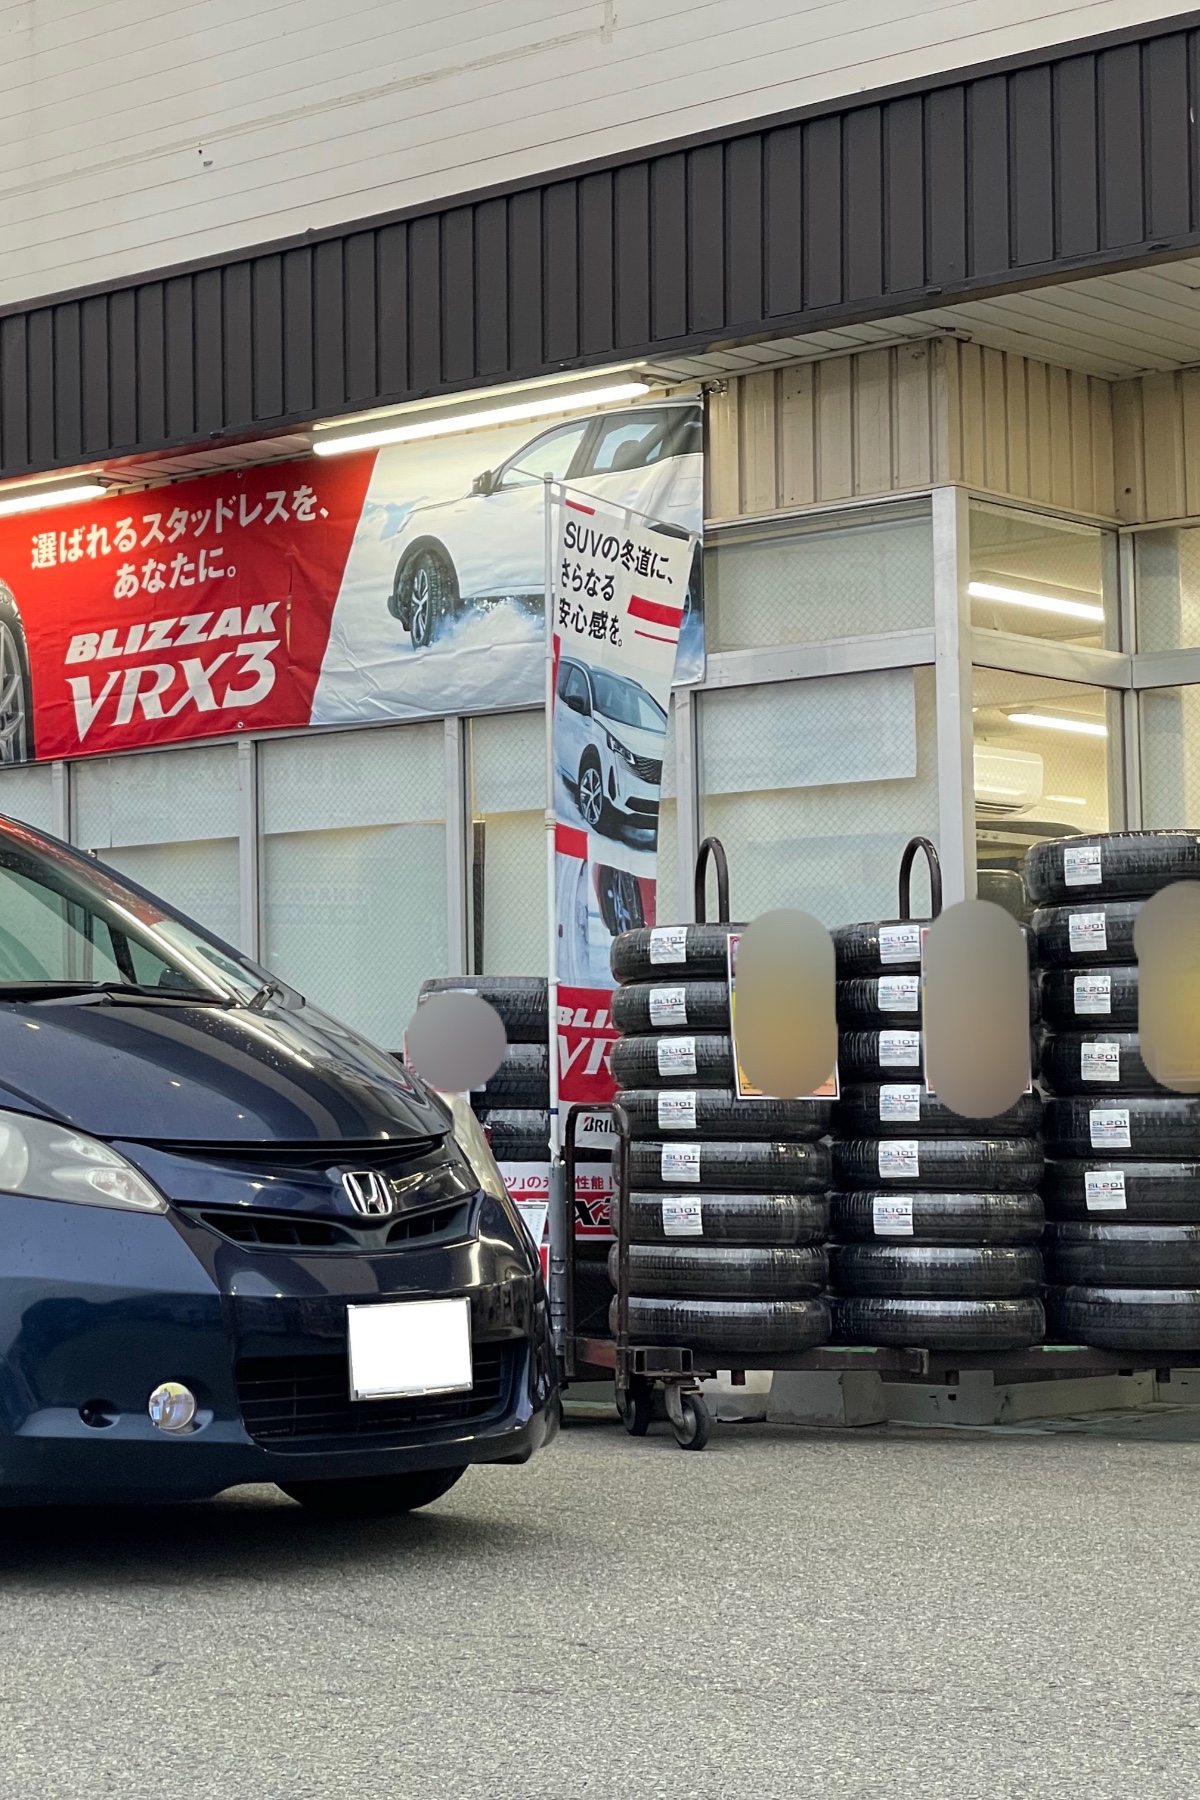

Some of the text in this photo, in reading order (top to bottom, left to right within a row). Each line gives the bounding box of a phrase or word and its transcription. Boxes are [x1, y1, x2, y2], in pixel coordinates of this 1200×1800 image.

[31, 485, 329, 569] 選ばれるスタッドレスを、
[563, 520, 673, 585] SUVの冬道に、
[113, 546, 237, 599] あなたに。
[561, 557, 615, 602] さらなる
[64, 601, 281, 665] BLIZZAK
[558, 597, 623, 648] 安心感を。
[64, 639, 281, 743] VRX3
[1071, 923, 1104, 931] SL201
[557, 1005, 614, 1029] BLI
[662, 1047, 691, 1055] SL101
[1083, 1053, 1117, 1061] SL201
